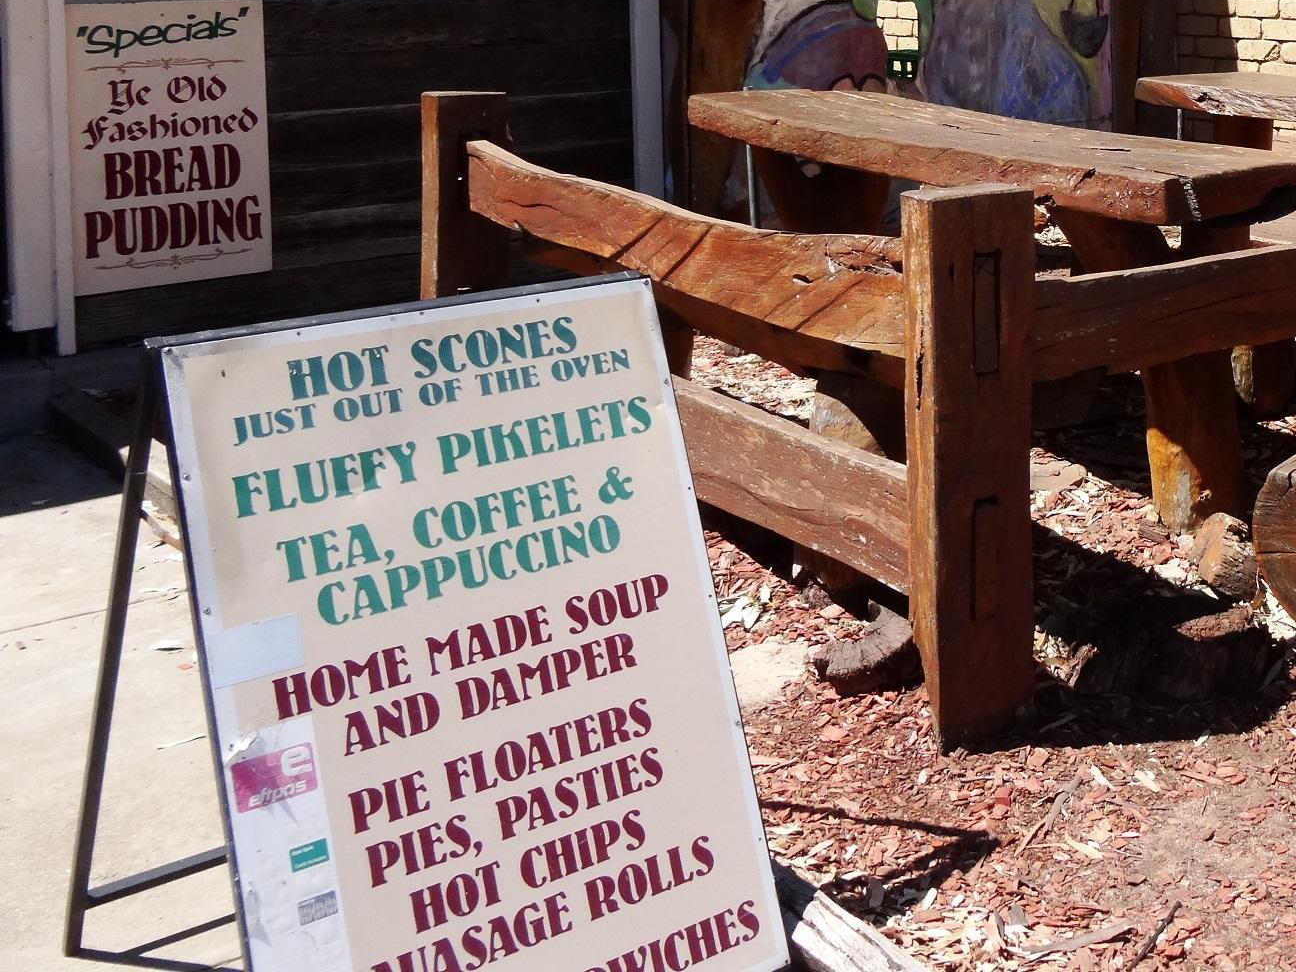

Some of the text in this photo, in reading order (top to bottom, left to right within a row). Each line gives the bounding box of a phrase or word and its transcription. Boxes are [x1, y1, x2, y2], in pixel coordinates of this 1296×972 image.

[166, 74, 228, 104] Old
[103, 143, 242, 200] BREAD
[84, 195, 263, 259] PUDDING
[231, 348, 632, 447] JUST OUT OF THE OVEN
[286, 316, 580, 402] HOT SCONES
[231, 395, 654, 519] FLUFFY PIKELETS
[275, 465, 635, 584] TEA, COFFEE &
[317, 514, 622, 627] CAPPUCCINO
[271, 573, 671, 722] HOME MADE SOUP
[343, 632, 639, 757] AND DAMPER
[247, 778, 308, 808] eftpos
[347, 697, 654, 834] PIE FLOATERS
[363, 745, 666, 889] PIES, PASTIES
[408, 860, 503, 935] HOT
[519, 808, 648, 890] CHIPS
[588, 835, 716, 922] ROLLS
[585, 899, 761, 972] WICHES
